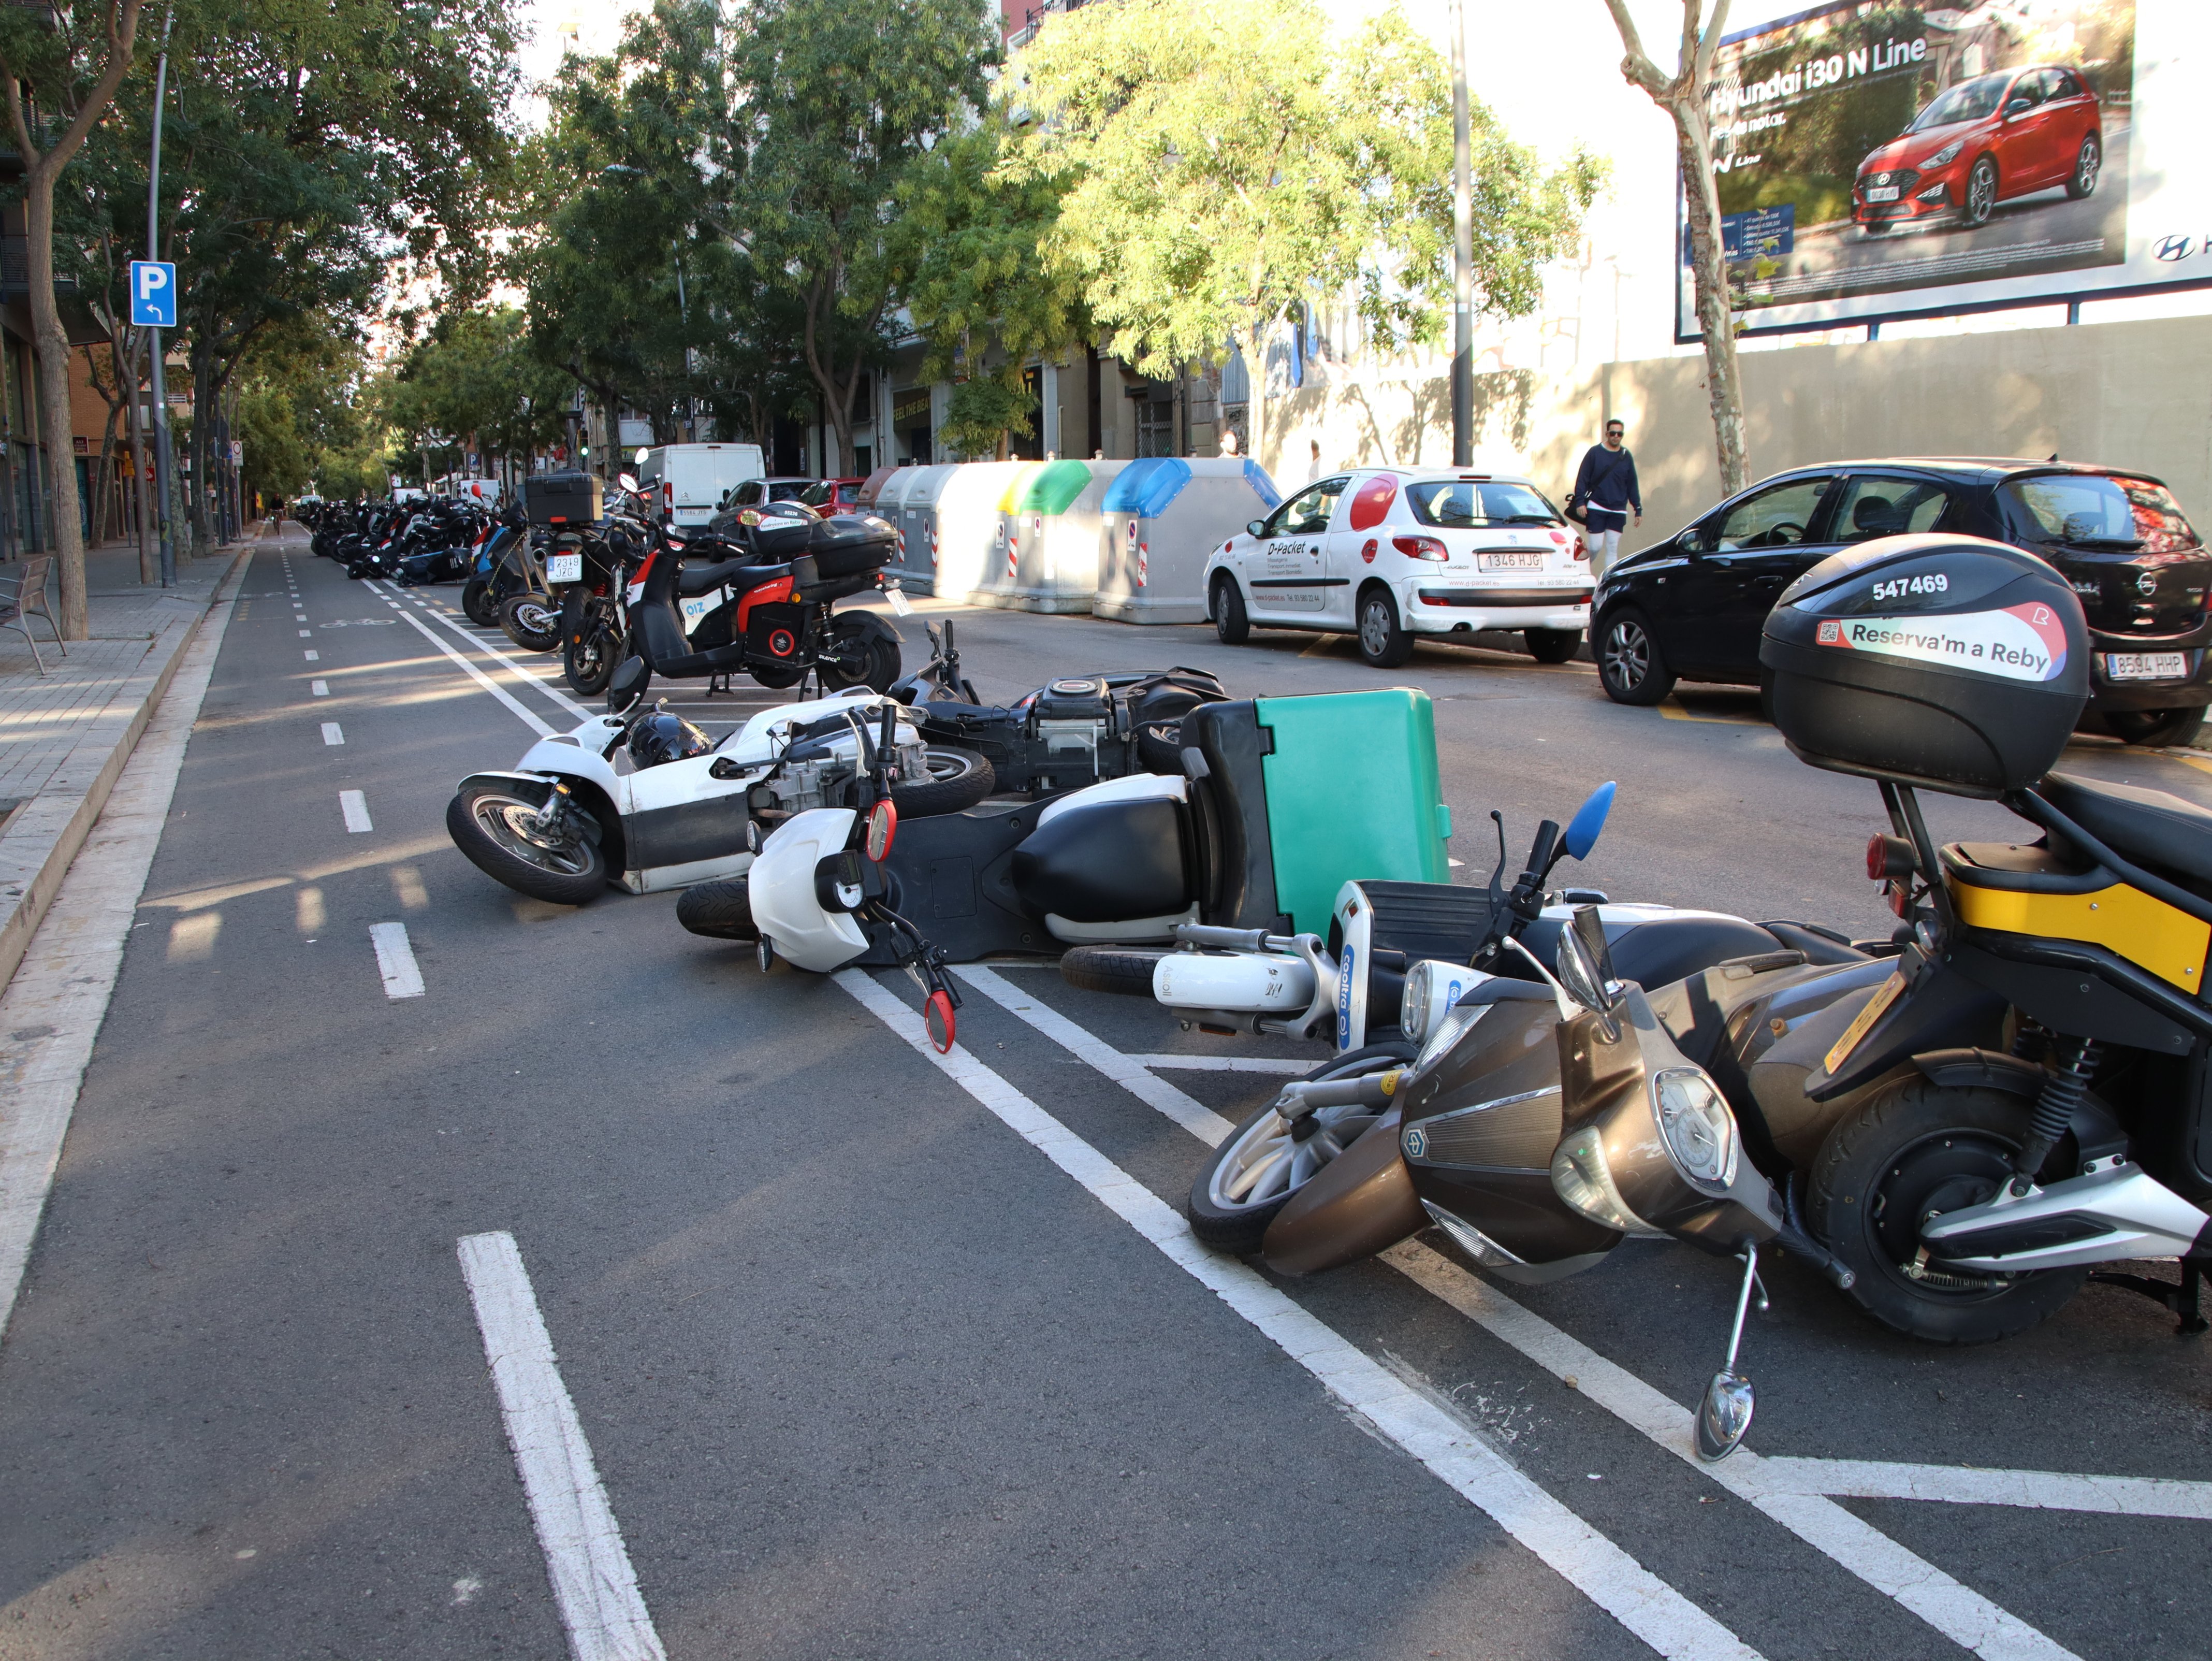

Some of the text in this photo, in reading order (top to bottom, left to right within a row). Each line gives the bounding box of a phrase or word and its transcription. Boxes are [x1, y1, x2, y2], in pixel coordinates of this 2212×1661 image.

[1710, 37, 1927, 115] Hyundai i30 N Line
[1749, 111, 1786, 132] notar.
[1735, 154, 1762, 167] Line
[140, 266, 167, 299] P
[906, 401, 916, 417] THE
[470, 454, 476, 465] P
[1268, 541, 1306, 555] D-Packet
[557, 557, 579, 568] 2319
[1488, 555, 1540, 567] 1346 HJG
[556, 568, 573, 577] JZG
[1873, 574, 1948, 601] 547469
[1852, 624, 2049, 673] Reserva'm a Reby
[818, 654, 837, 663] SILENCE
[2118, 656, 2181, 673] 8594 HHP
[1162, 964, 1174, 997] Askoll
[1340, 955, 1350, 1009] cooltra
